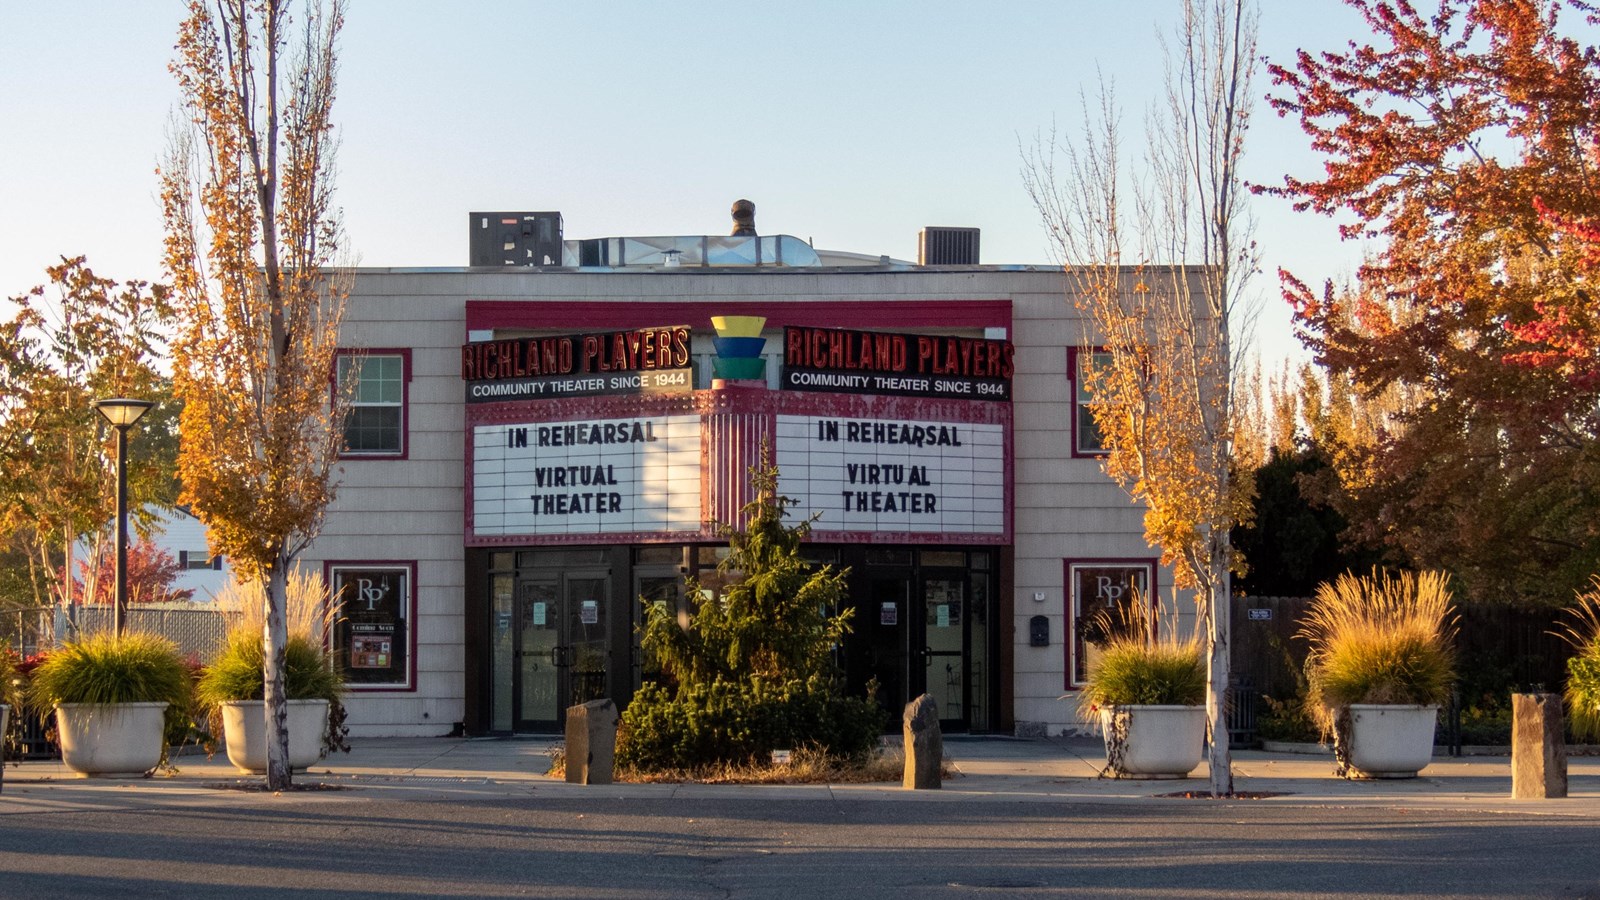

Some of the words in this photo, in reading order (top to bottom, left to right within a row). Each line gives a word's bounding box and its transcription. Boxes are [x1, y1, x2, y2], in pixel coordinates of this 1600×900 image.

[462, 338, 573, 380] RICHLAND
[583, 328, 688, 372] PLAYERS
[787, 328, 906, 372] RICHLAND
[918, 337, 1015, 379] PLAYERS
[473, 382, 546, 397] COMMUNITY
[550, 379, 605, 393] THEATER
[611, 375, 649, 389] SINCE
[654, 373, 685, 386] 1944
[790, 372, 869, 388] COMMUNITY
[874, 377, 928, 391] THEATER
[934, 380, 971, 393] SINCE
[975, 383, 1004, 395] 1944
[508, 428, 527, 448] IN
[538, 421, 657, 447] REHEARSAL
[818, 420, 838, 441] IN
[847, 421, 961, 447] REHEARSAL
[535, 464, 617, 487] VIRTUAL
[847, 463, 930, 485] VIRTUAL
[531, 492, 621, 515] THEATER
[842, 491, 936, 513] THEATER
